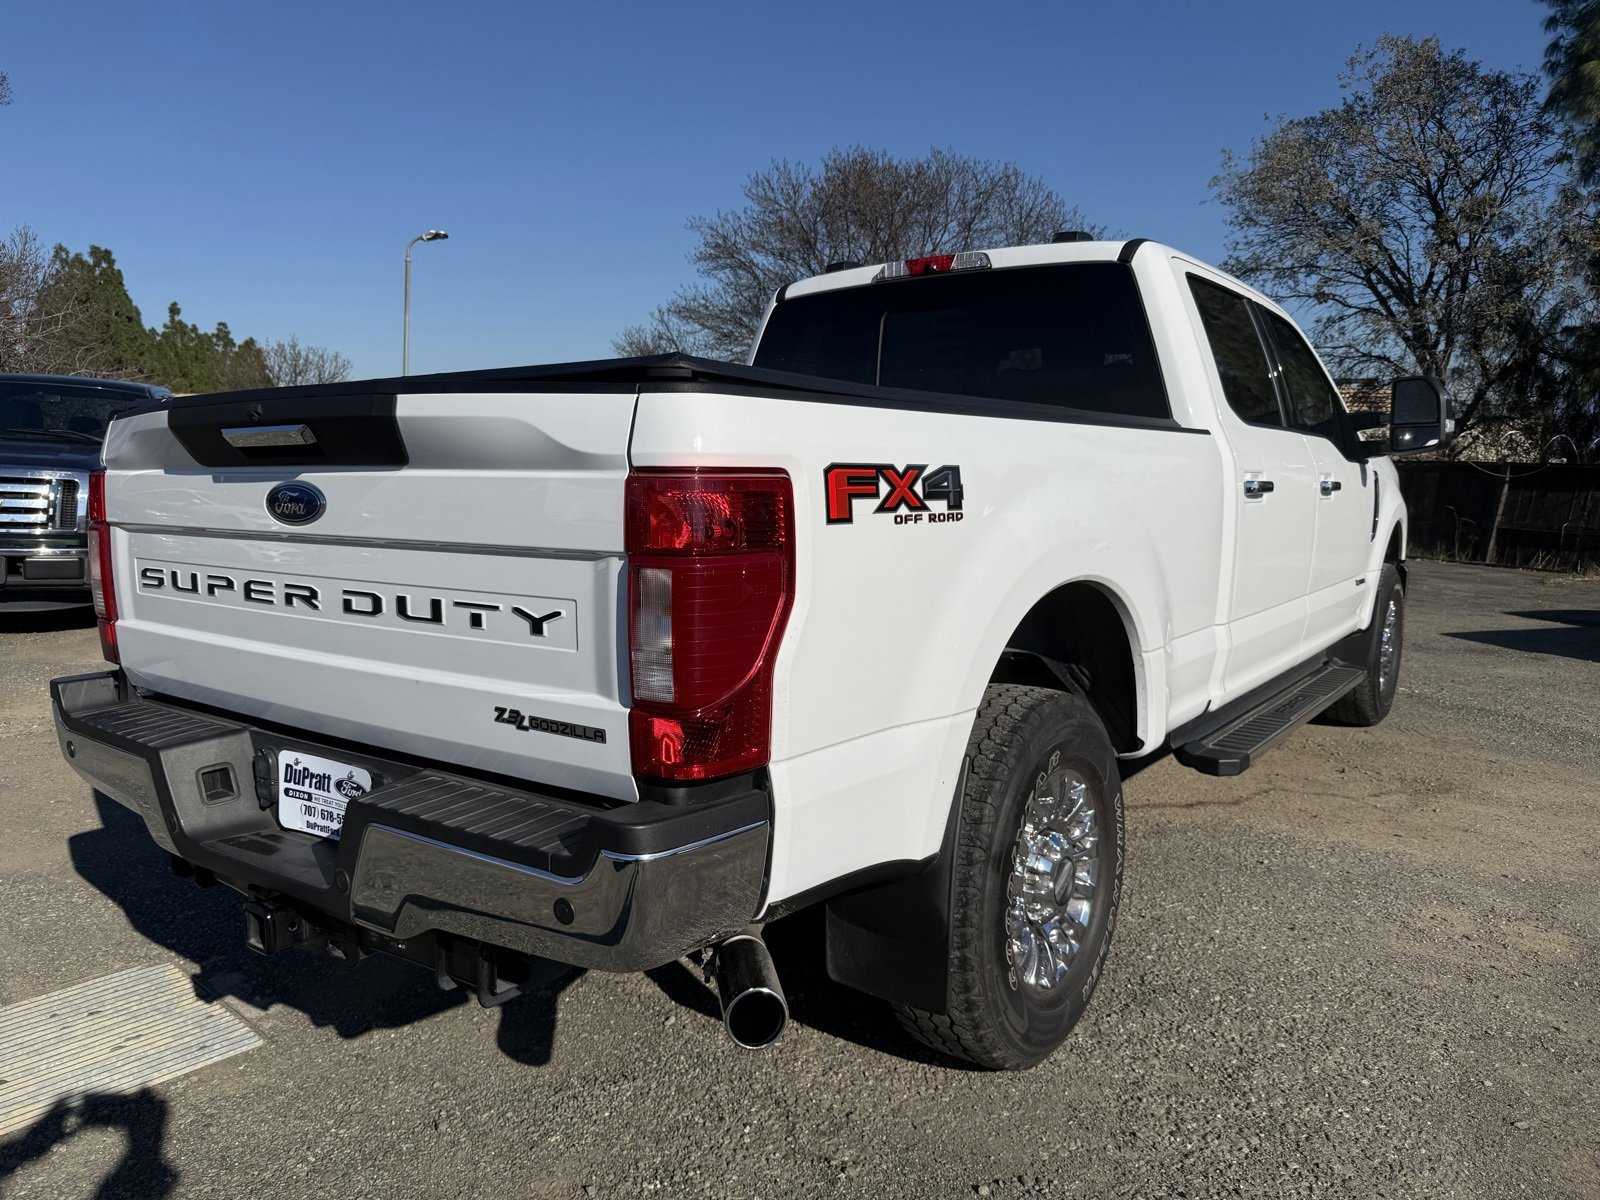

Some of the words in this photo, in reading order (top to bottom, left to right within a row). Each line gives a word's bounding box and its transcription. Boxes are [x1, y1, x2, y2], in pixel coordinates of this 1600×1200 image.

[275, 490, 307, 515] Ford
[823, 462, 964, 525] FX4
[894, 514, 923, 525] OFF
[928, 512, 964, 523] ROAD
[141, 567, 321, 611] SUPER
[342, 588, 566, 637] DUTY
[529, 716, 606, 743] GODZILLA
[284, 763, 332, 793] DuPratt
[341, 780, 362, 797] Ford
[288, 789, 309, 799] DIXON
[300, 802, 320, 820] (707)
